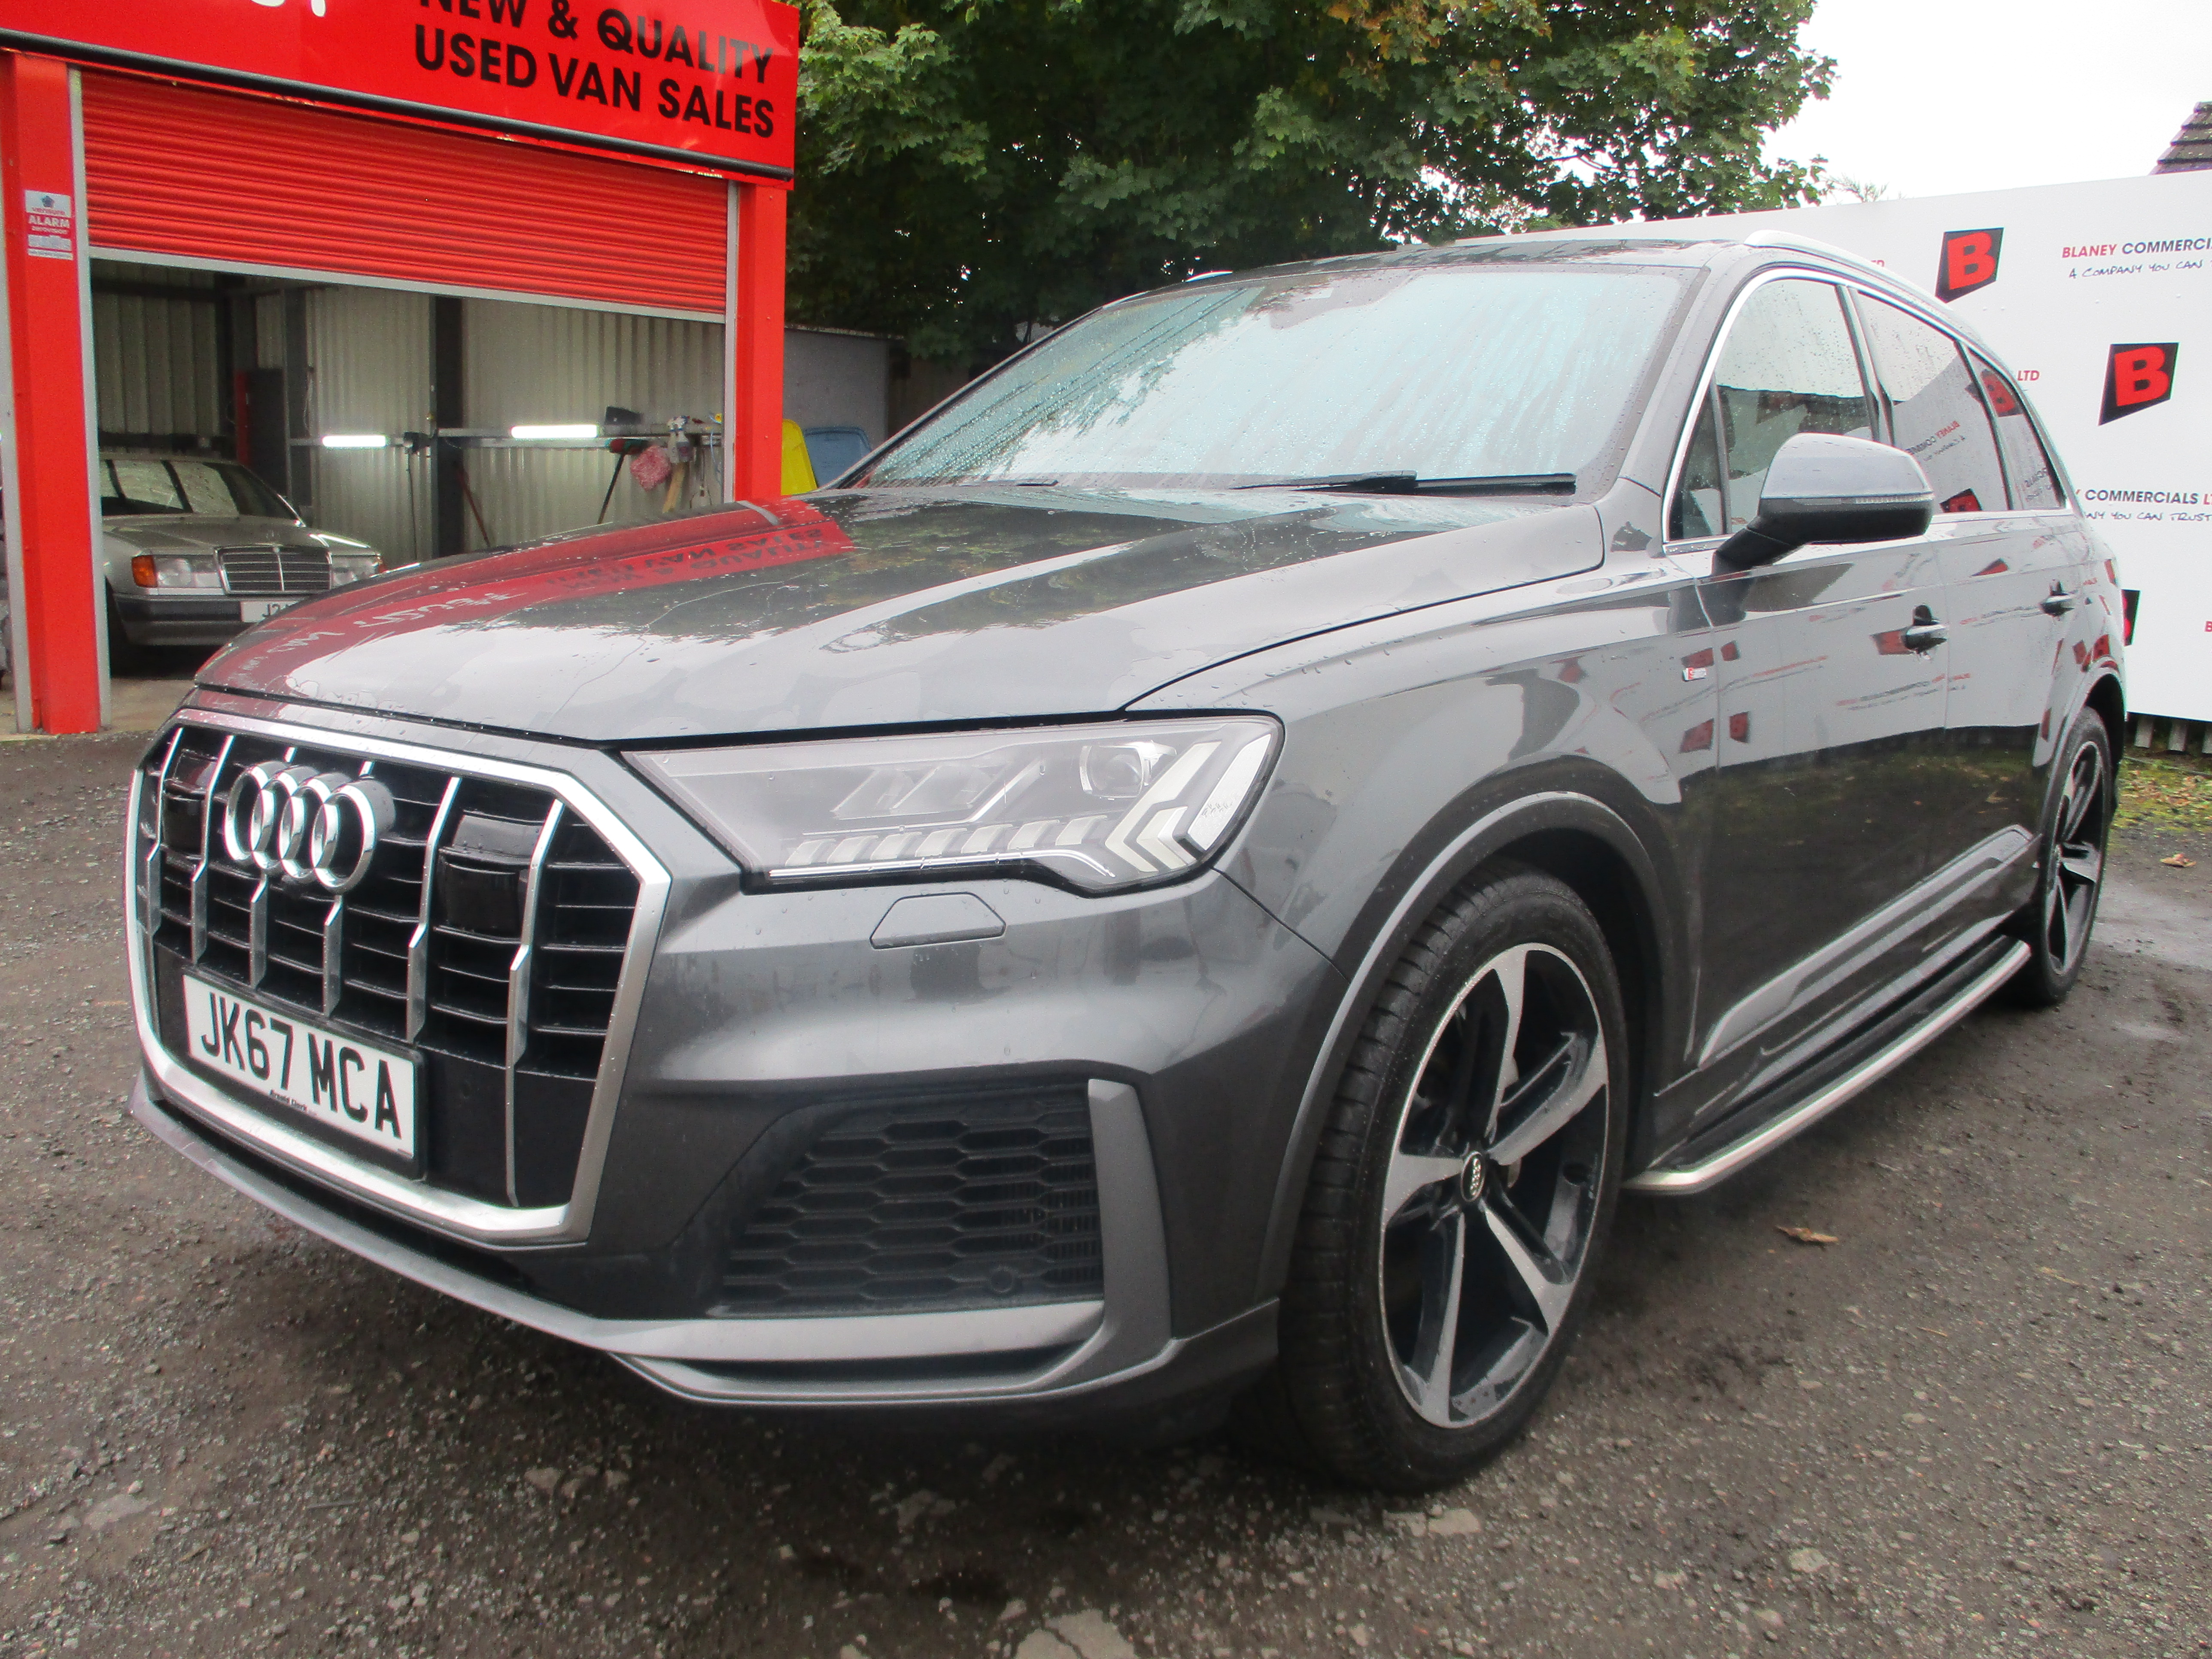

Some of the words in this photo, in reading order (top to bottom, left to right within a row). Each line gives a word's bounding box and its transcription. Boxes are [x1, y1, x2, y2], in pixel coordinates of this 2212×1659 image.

[548, 0, 578, 40] &
[597, 9, 773, 84] QUALITY
[415, 24, 537, 88] USED
[548, 53, 640, 112] VAN
[658, 78, 773, 138] SALES
[28, 215, 70, 229] ALARM
[1947, 232, 1995, 290] B
[2062, 244, 2117, 258] BLANEY
[2122, 237, 2212, 254] COMMERCI
[2069, 267, 2077, 279] A
[2176, 259, 2203, 269] CAN
[2018, 370, 2040, 381] LTD
[2115, 346, 2169, 407] B
[2084, 489, 2199, 505] COMMERCIALS
[201, 992, 294, 1091] JK67
[307, 1032, 402, 1139] MCA
